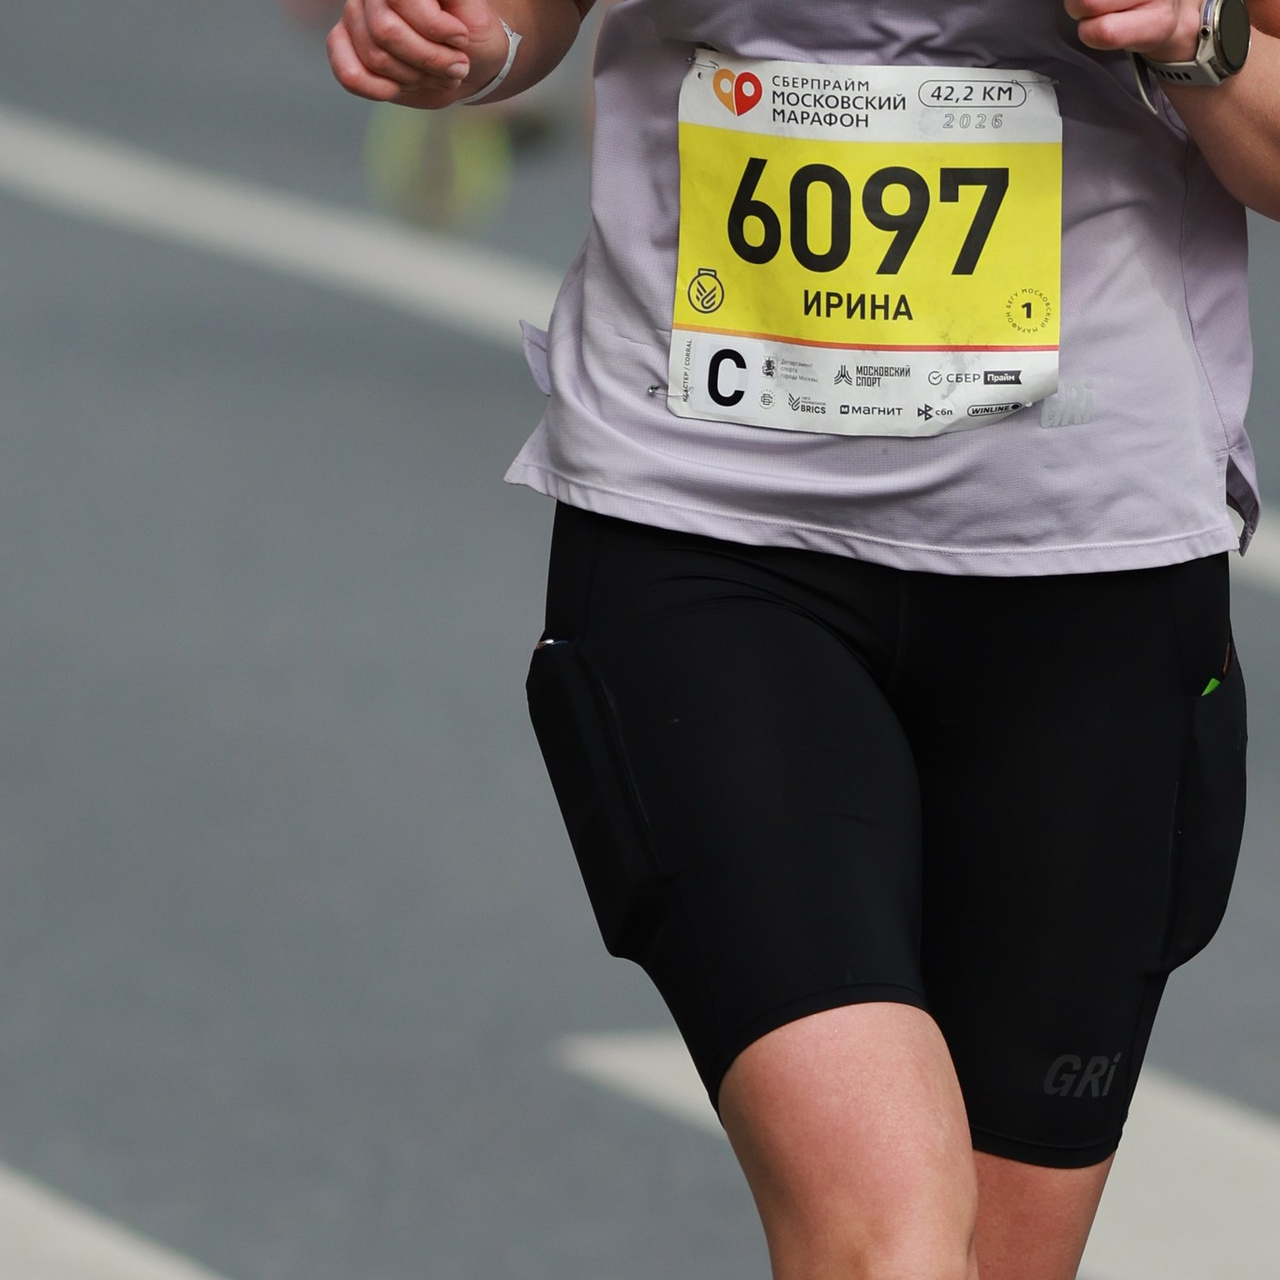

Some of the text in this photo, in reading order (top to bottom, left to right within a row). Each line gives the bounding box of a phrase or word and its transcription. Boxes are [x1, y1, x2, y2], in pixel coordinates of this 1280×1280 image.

[772, 75, 869, 91] СБЕРПРАЙМ
[772, 90, 906, 110] МОСКОВСКИЙ
[930, 85, 974, 103] 42,2
[772, 108, 868, 127] МАРАФОН
[943, 113, 1003, 129] 2026
[727, 157, 1009, 276] 6097
[804, 290, 913, 321] ИРИНА
[1021, 302, 1032, 319] 1
[856, 364, 911, 377] МОСКОВСКИЙ
[946, 373, 1015, 383] СБЕР Прайм
[856, 376, 881, 387] СПОРТ
[800, 405, 826, 414] BRICS
[851, 405, 903, 416] магнит
[935, 408, 953, 416] сбп
[971, 405, 1010, 415] WINLINE
